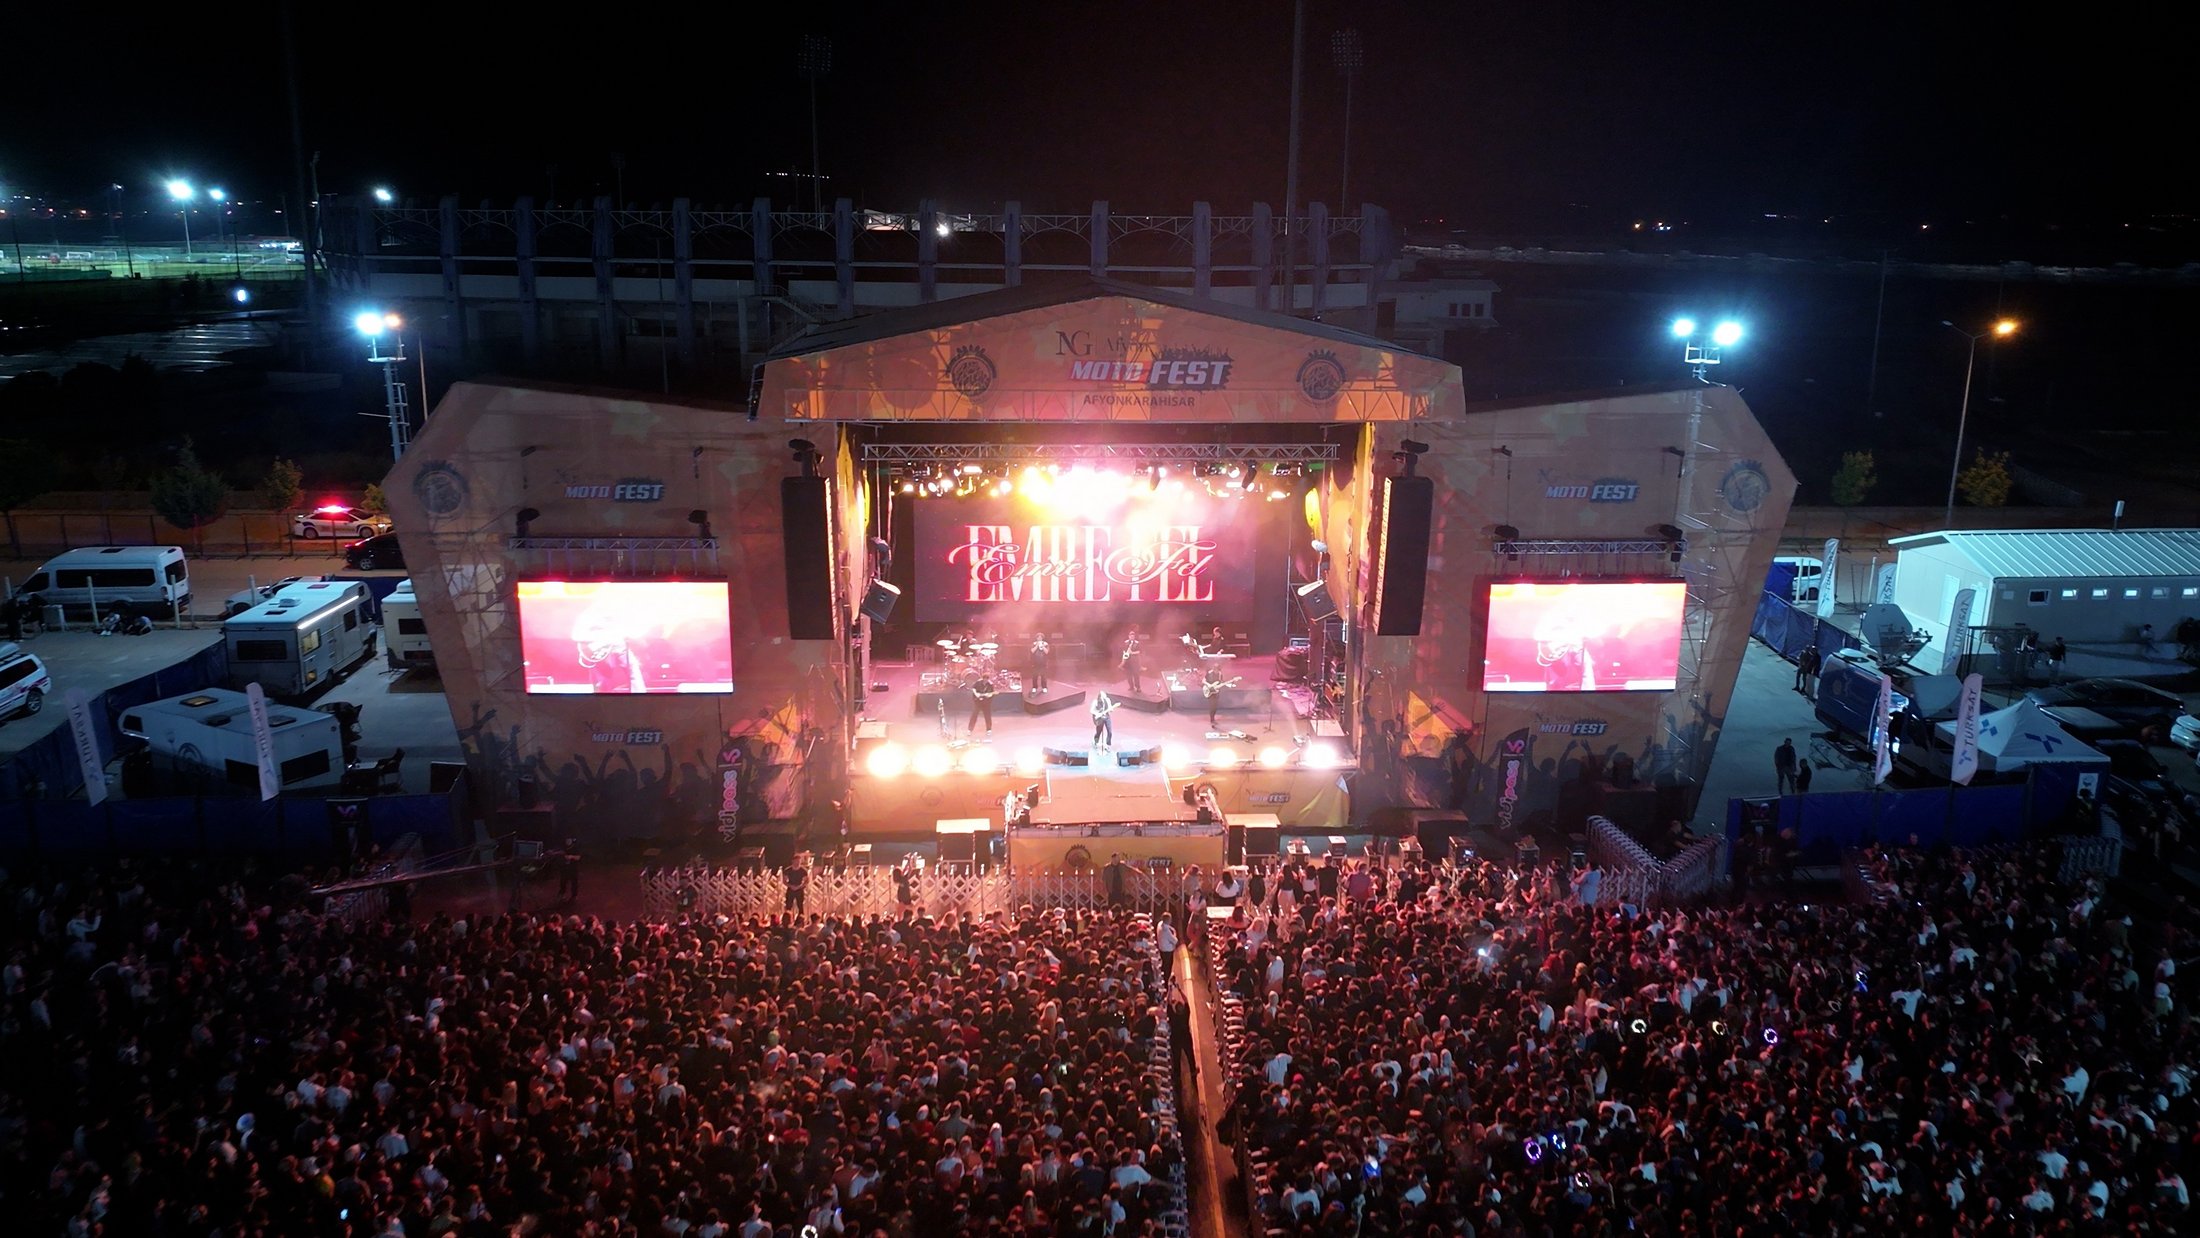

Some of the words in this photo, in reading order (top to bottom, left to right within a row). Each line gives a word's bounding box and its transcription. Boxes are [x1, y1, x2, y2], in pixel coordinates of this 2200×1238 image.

[1056, 330, 1094, 356] NG
[1070, 360, 1145, 381] MOTO
[1150, 360, 1231, 385] FEST
[1083, 394, 1196, 407] AFYONKARAHİSAR
[564, 486, 611, 498] MOTO
[614, 484, 664, 500] FEST
[1545, 486, 1589, 498] MOTO
[1591, 485, 1640, 500] FEST
[1964, 688, 1977, 747] TURKSAT
[1540, 724, 1571, 733] MOTO
[1572, 723, 1608, 734] FEST
[591, 733, 625, 742] MOTO
[626, 731, 663, 743] FEST
